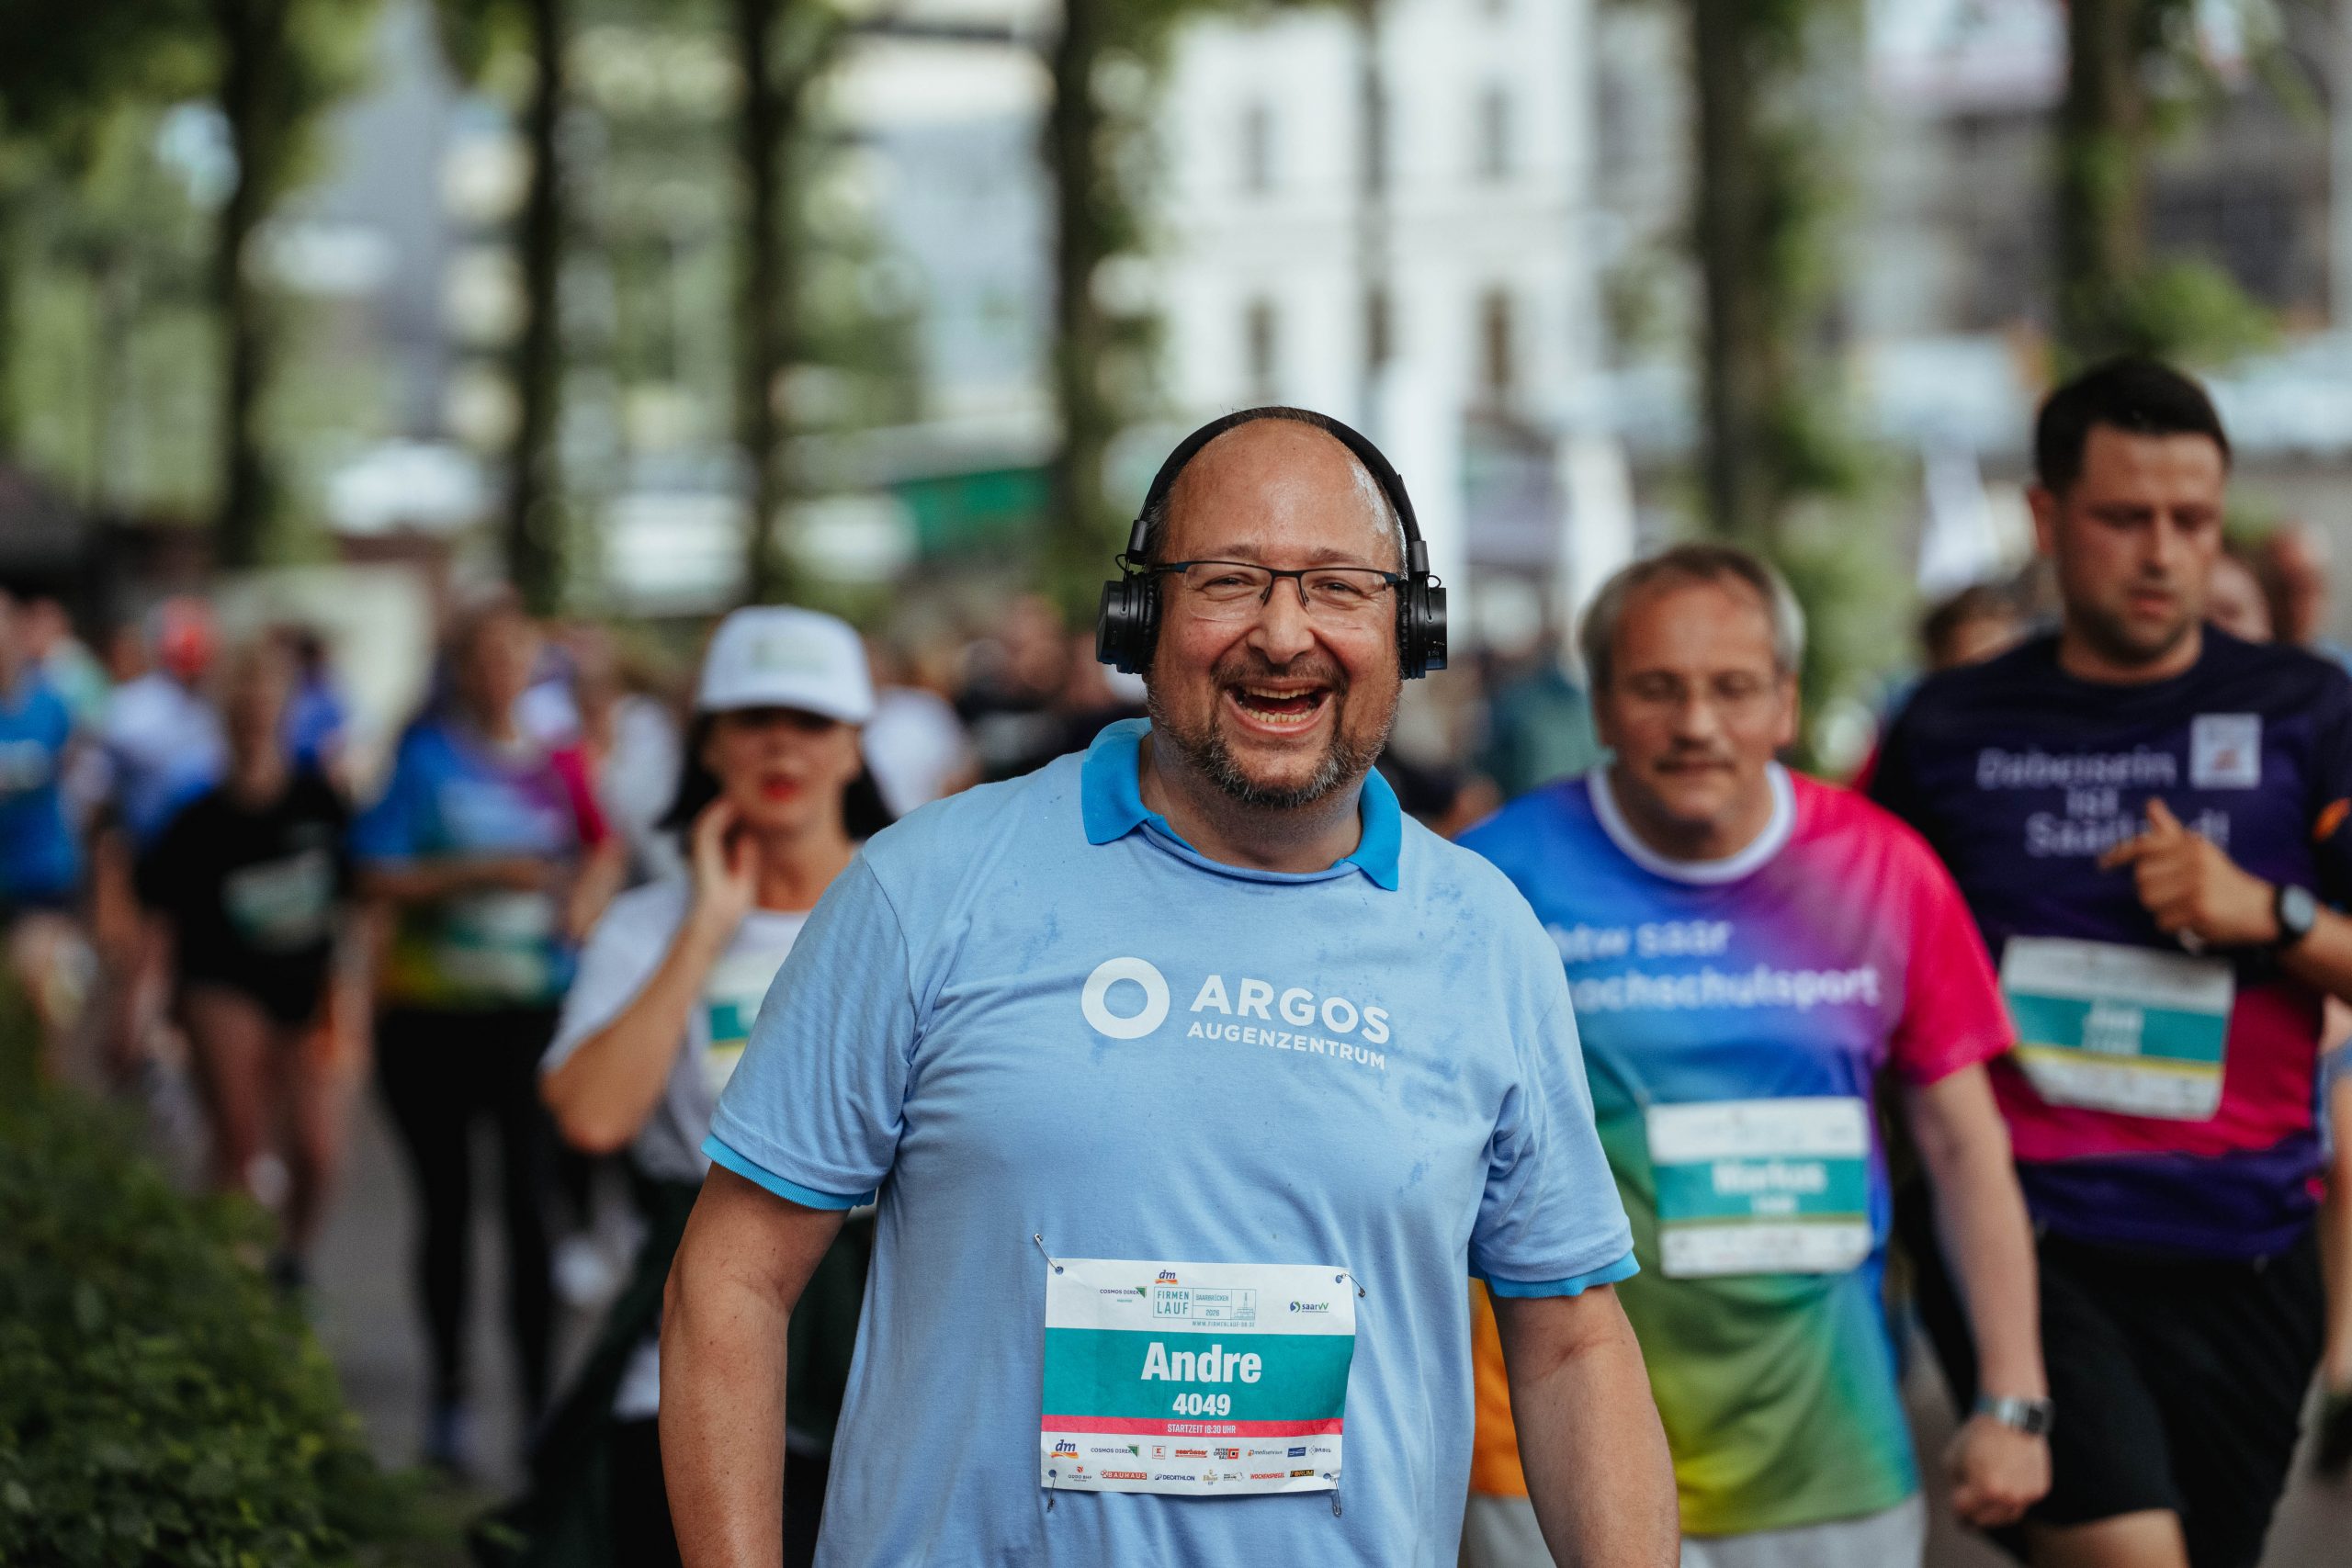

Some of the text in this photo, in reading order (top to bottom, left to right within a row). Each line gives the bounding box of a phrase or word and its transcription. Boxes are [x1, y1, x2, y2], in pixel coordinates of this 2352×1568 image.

[1636, 920, 1734, 957] saar
[1569, 964, 1880, 1010] ochschulsport
[1190, 975, 1390, 1044] ARGOS
[1187, 1021, 1385, 1070] AUGENZENTRUM
[1159, 1269, 1176, 1279] dm
[1158, 1291, 1189, 1300] FIRMEN
[1158, 1302, 1189, 1314] LAUF
[1140, 1342, 1262, 1383] Andre
[1172, 1393, 1231, 1416] 4049
[1167, 1424, 1236, 1434] STARTZEIT 18:30 UHR
[1055, 1439, 1076, 1451] dm
[1108, 1472, 1147, 1480] BAUHAUS
